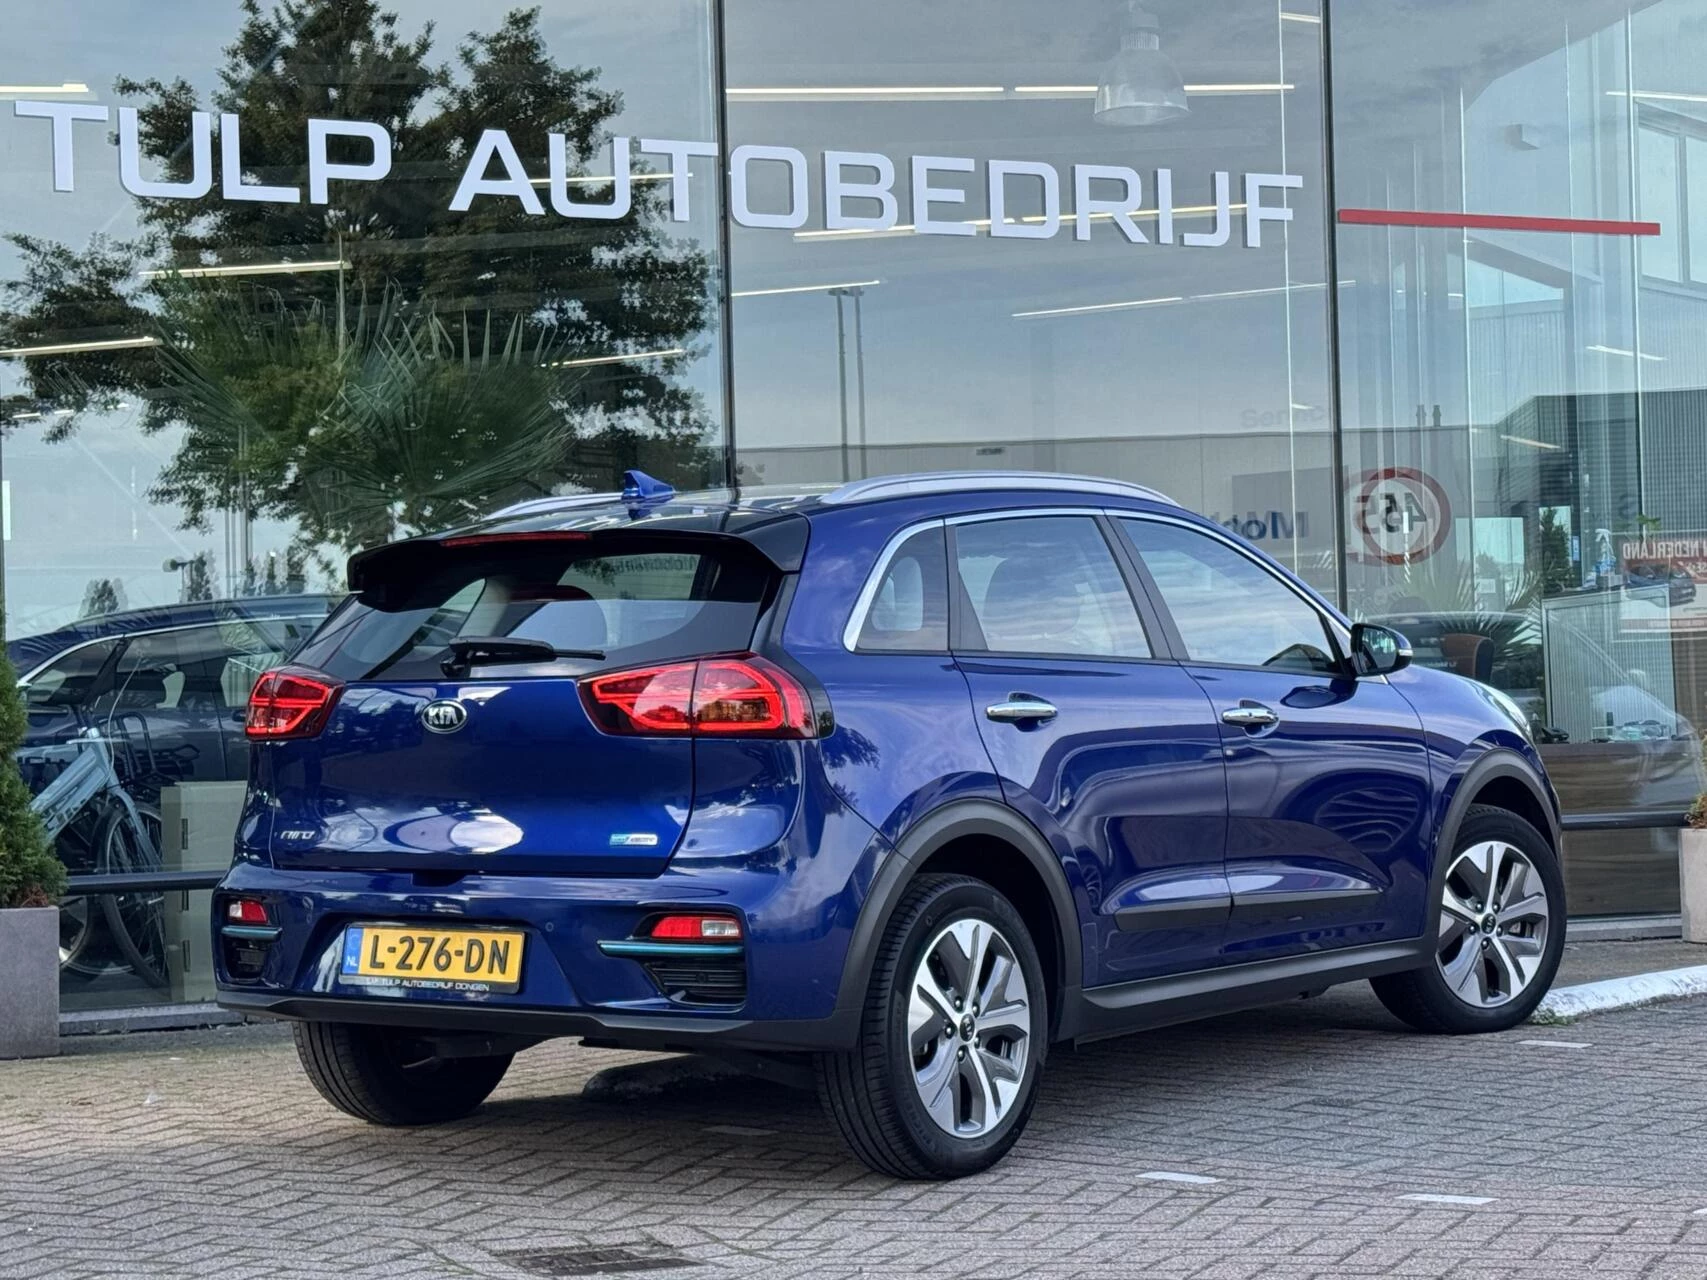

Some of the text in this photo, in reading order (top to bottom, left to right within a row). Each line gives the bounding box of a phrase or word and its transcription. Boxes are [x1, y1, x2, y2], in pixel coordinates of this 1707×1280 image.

[15, 100, 1303, 248] TULP AUTOBEDRIJF
[428, 706, 458, 724] KIA
[345, 956, 358, 968] NL
[369, 934, 510, 975] L-276-DN
[455, 982, 490, 992] DONGEN
